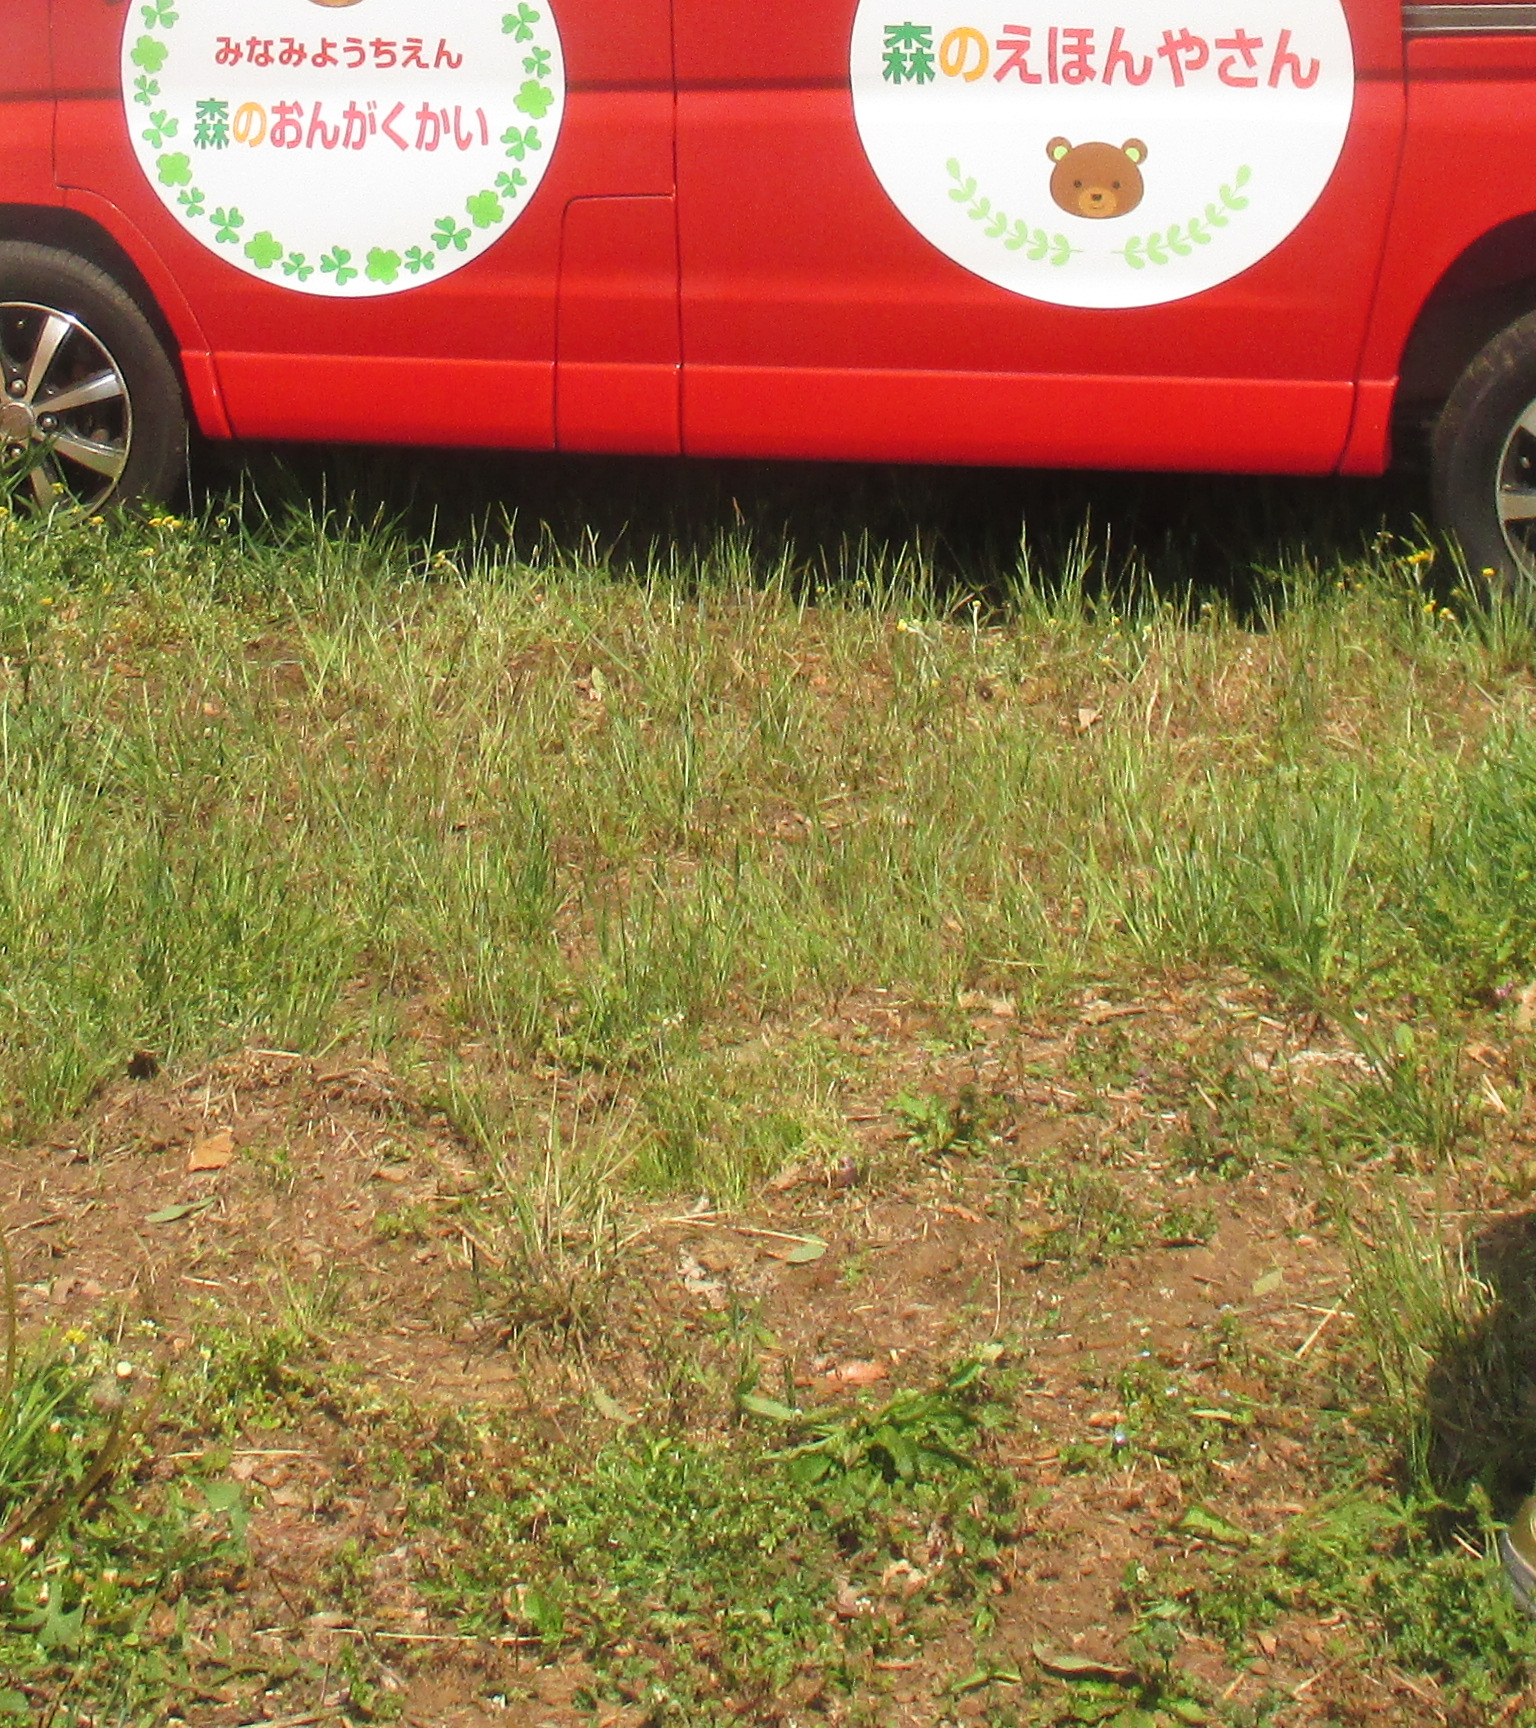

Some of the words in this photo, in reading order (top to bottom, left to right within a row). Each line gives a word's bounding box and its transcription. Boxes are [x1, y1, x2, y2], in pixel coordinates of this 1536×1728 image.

[214, 35, 464, 69] みなみようちえん
[881, 20, 1322, 89] 森のえほんやさん
[192, 97, 490, 151] 森のおんがくかい
